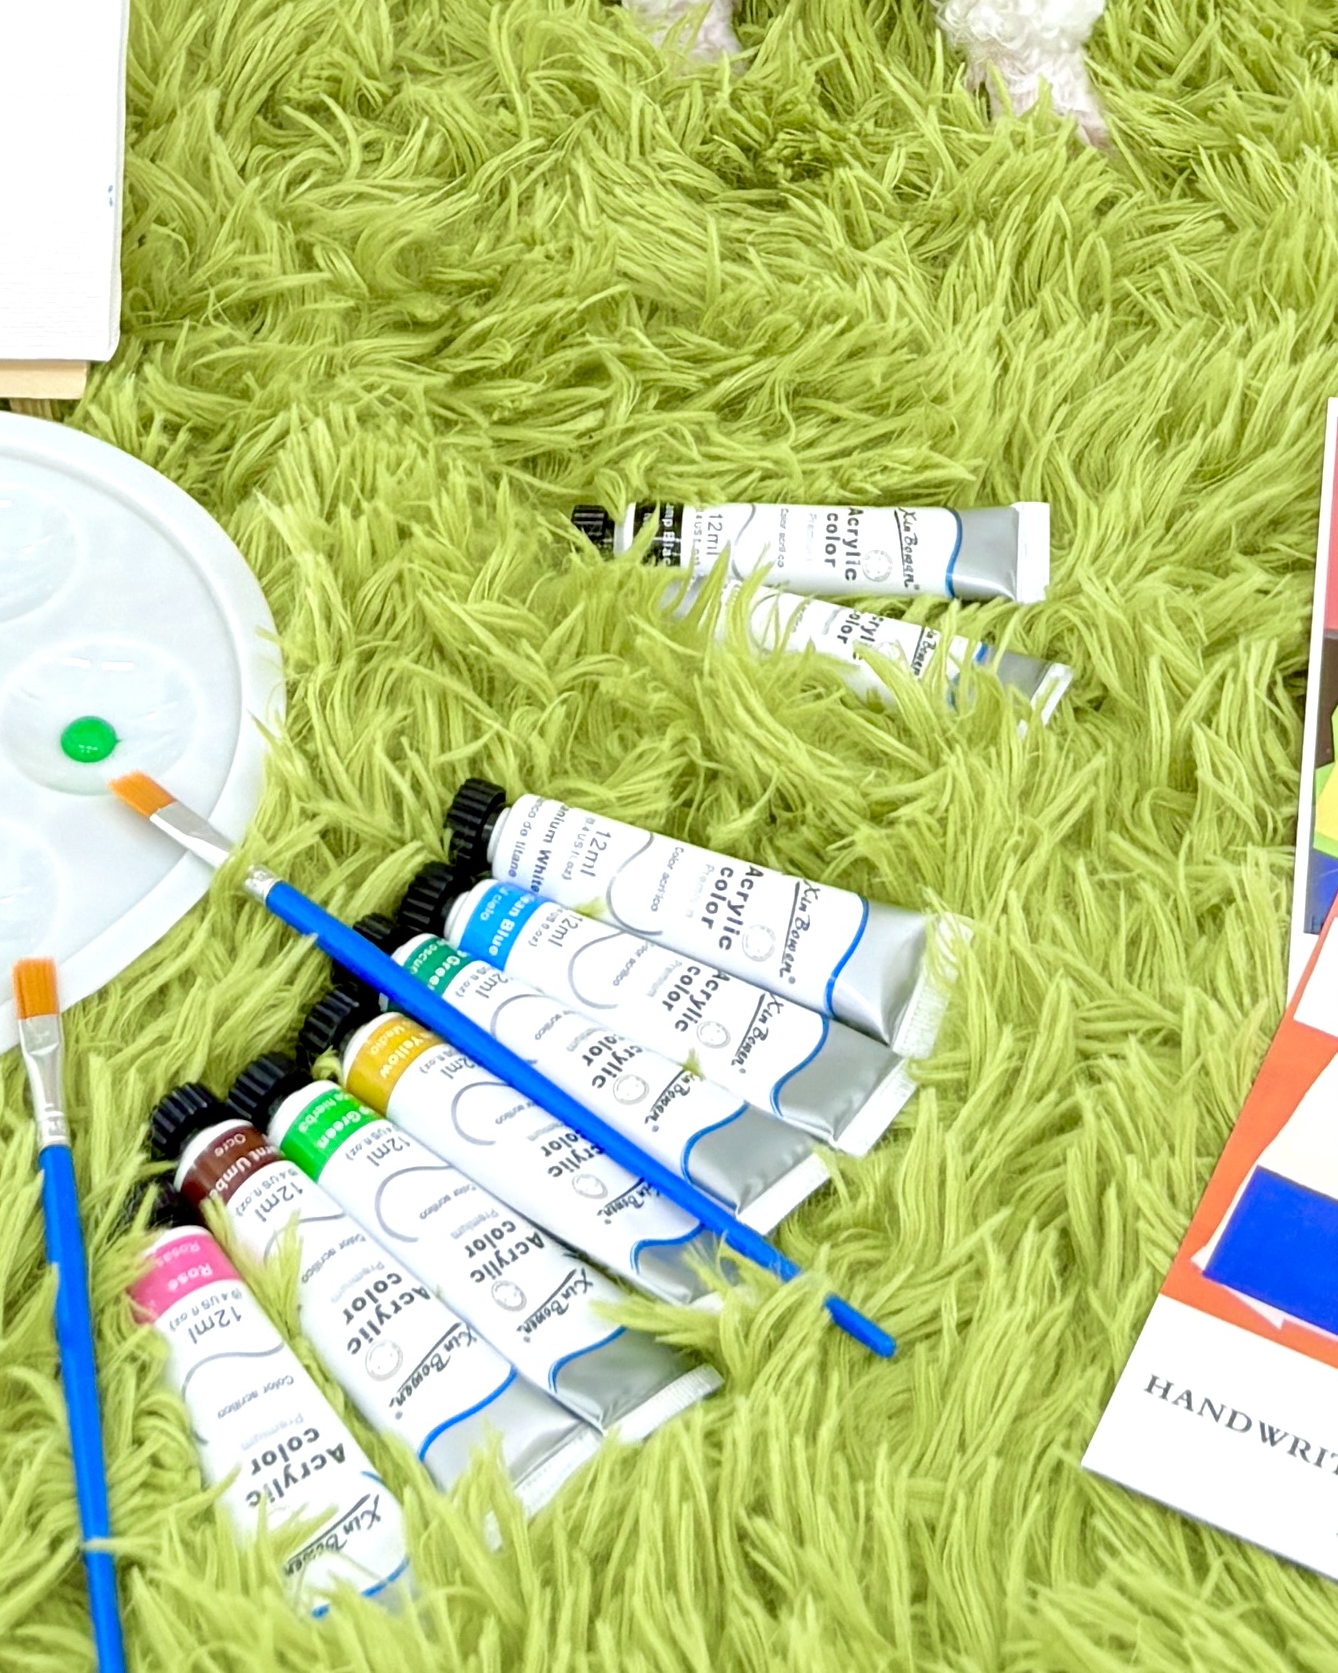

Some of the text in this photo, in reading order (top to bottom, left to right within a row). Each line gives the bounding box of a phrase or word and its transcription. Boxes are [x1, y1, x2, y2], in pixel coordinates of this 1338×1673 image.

[705, 512, 723, 556] 12ml
[822, 512, 841, 567] color
[840, 507, 864, 581] Acrylic
[525, 847, 555, 894] White
[579, 827, 612, 878] 12ml
[698, 864, 736, 931] color
[711, 862, 764, 953] Acrylic
[486, 916, 516, 959] Blue
[547, 914, 583, 947] 12ml
[474, 972, 507, 999] 2ml
[661, 966, 699, 1011] color
[672, 969, 730, 1034] Acrylic
[377, 1034, 423, 1079] Yellow
[439, 1055, 474, 1080] 2ml
[590, 1043, 642, 1090] crylic
[213, 1132, 245, 1158] Ocre
[315, 1109, 360, 1150] Green
[365, 1135, 410, 1166] 12ml
[540, 1133, 578, 1156] olor
[547, 1143, 602, 1179] crylic
[254, 1180, 302, 1222] 12ml
[464, 1219, 514, 1258] color
[468, 1231, 545, 1285] Acrylic
[166, 1262, 214, 1291] Rose
[340, 1271, 402, 1326] color
[185, 1301, 243, 1346] 12ml
[344, 1286, 429, 1358] Acrylic
[261, 1370, 295, 1397] Color
[244, 1424, 323, 1480] color
[240, 1436, 350, 1514] Acrylic
